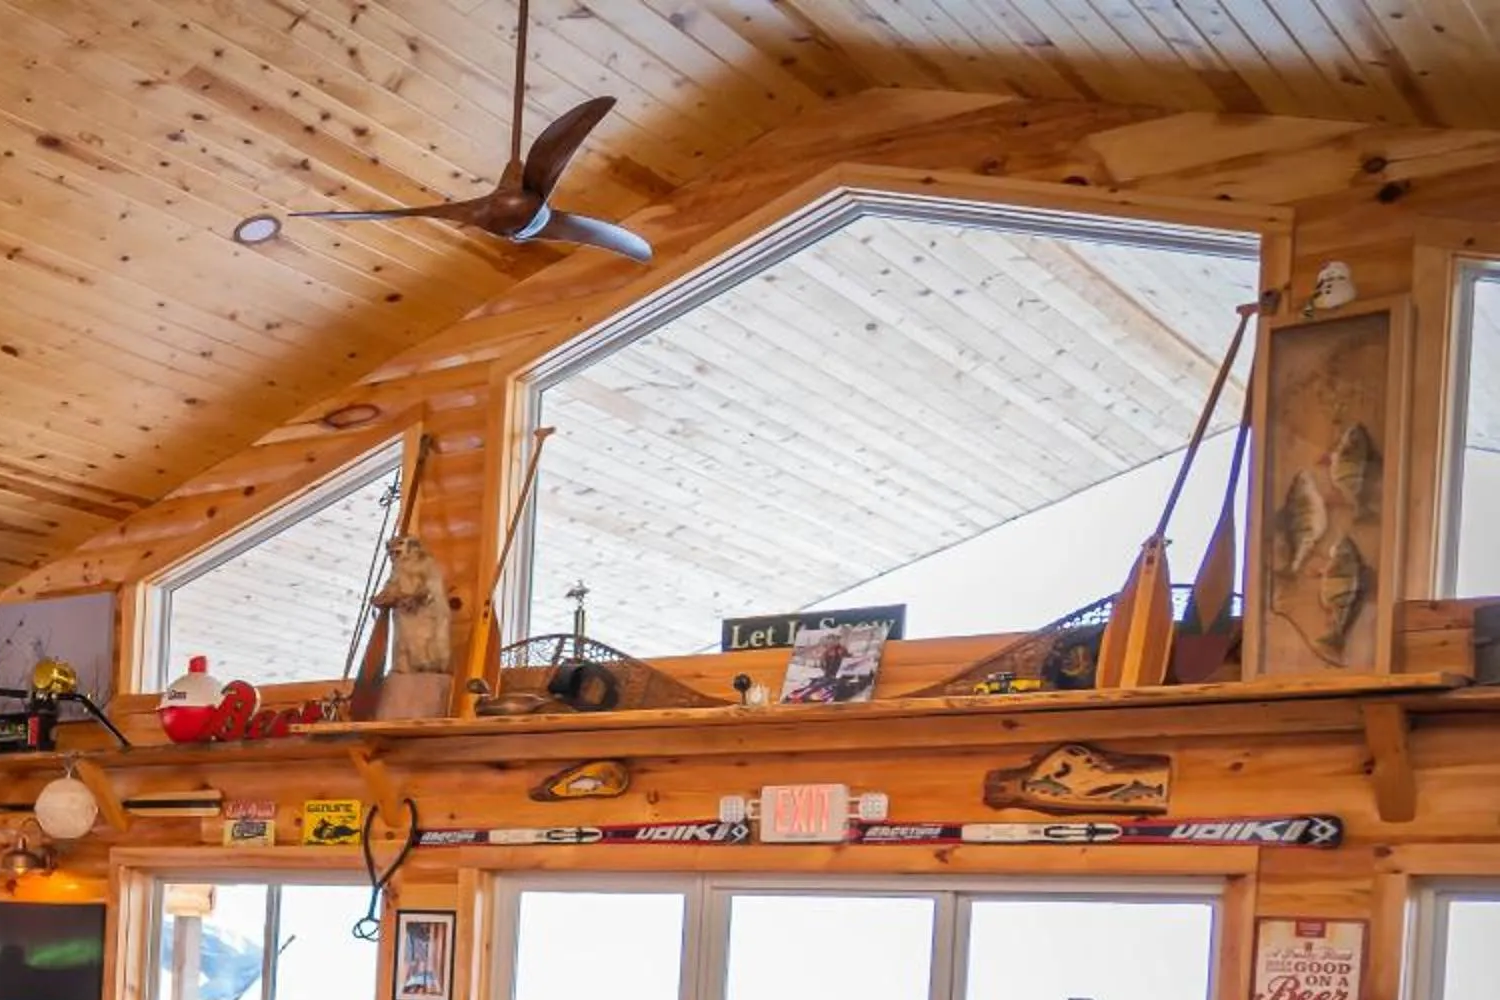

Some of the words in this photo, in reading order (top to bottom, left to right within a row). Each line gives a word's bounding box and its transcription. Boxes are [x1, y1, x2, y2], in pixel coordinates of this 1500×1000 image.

[731, 625, 776, 649] Let
[775, 788, 832, 833] EXIT
[1294, 961, 1351, 975] GOOD
[1305, 975, 1332, 987] ON
[1338, 976, 1349, 987] A
